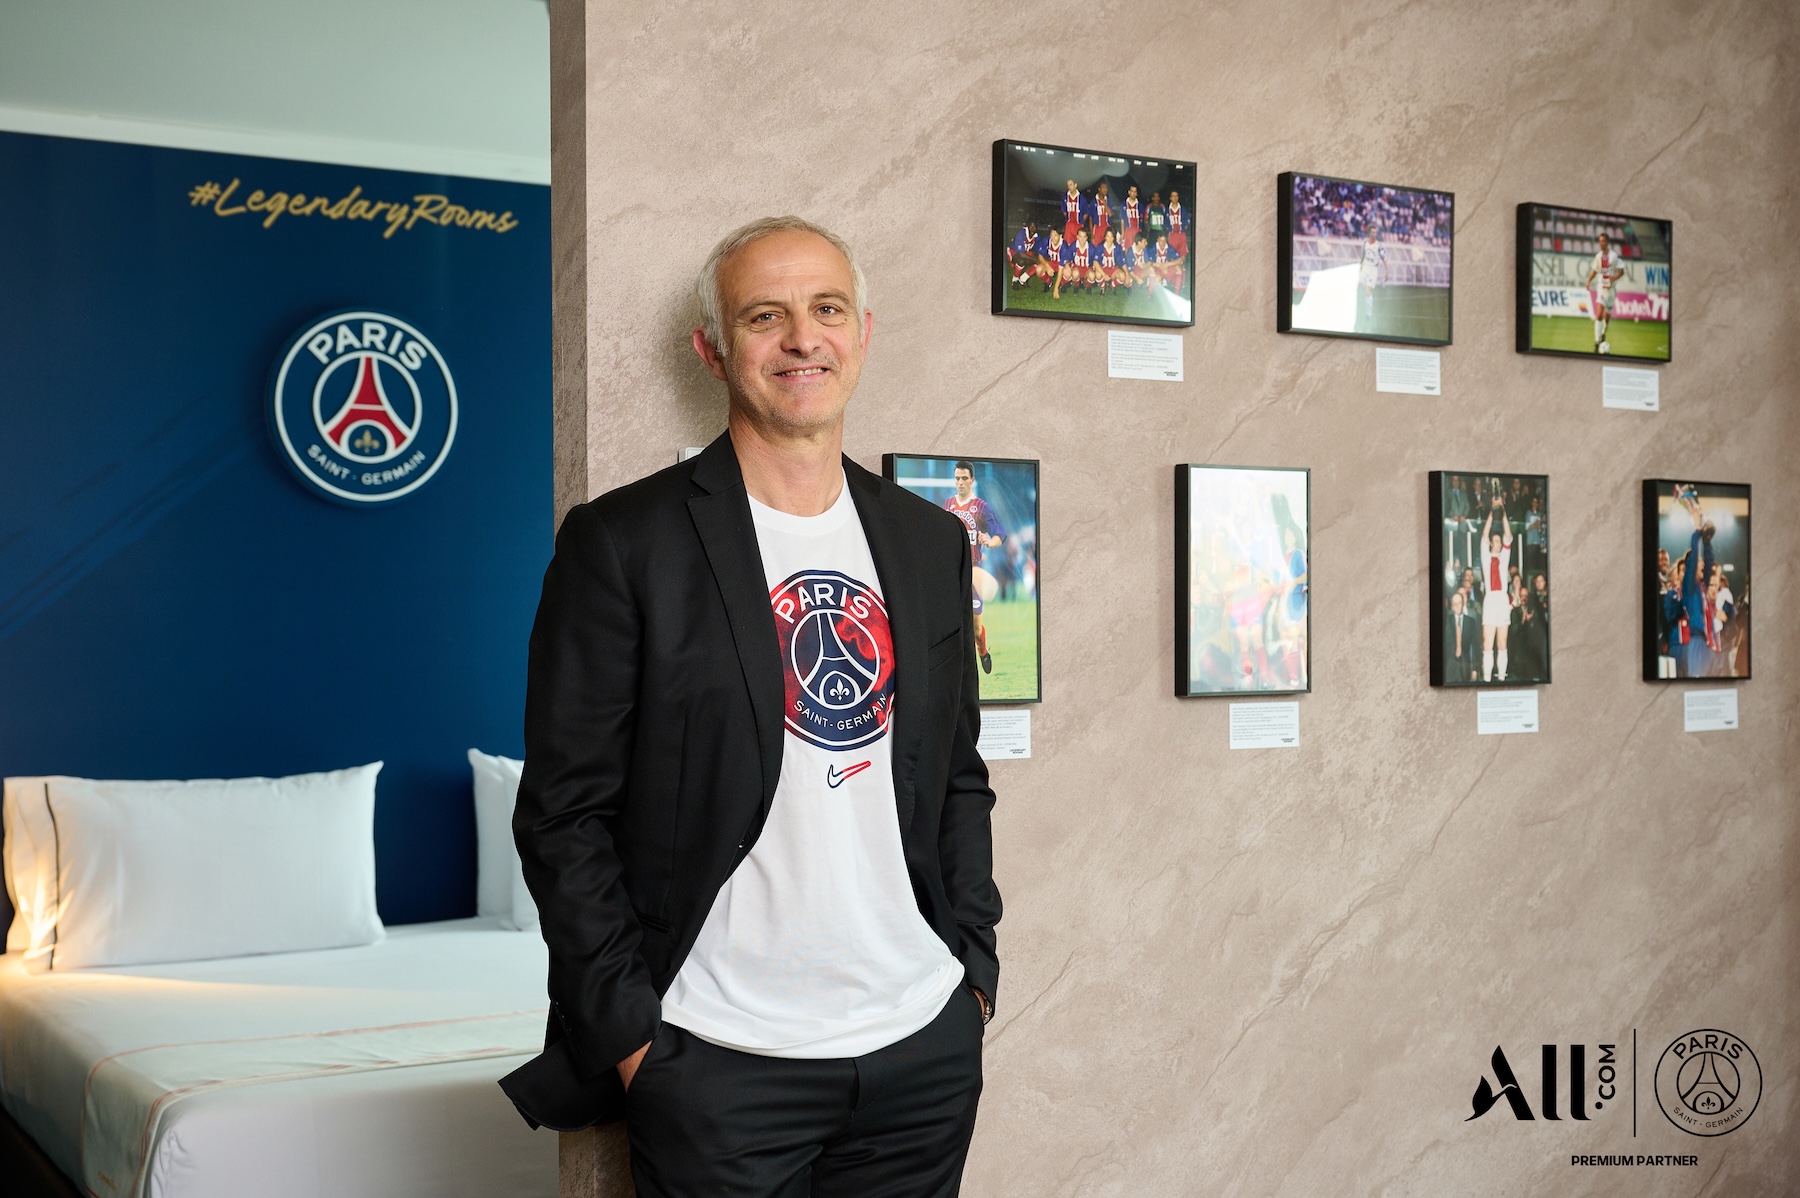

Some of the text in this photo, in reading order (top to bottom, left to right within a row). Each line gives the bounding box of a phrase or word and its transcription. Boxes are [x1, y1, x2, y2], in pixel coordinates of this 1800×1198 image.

[188, 178, 519, 239] #LegendaryRooms
[307, 321, 428, 371] PARIS
[775, 583, 872, 624] PARIS
